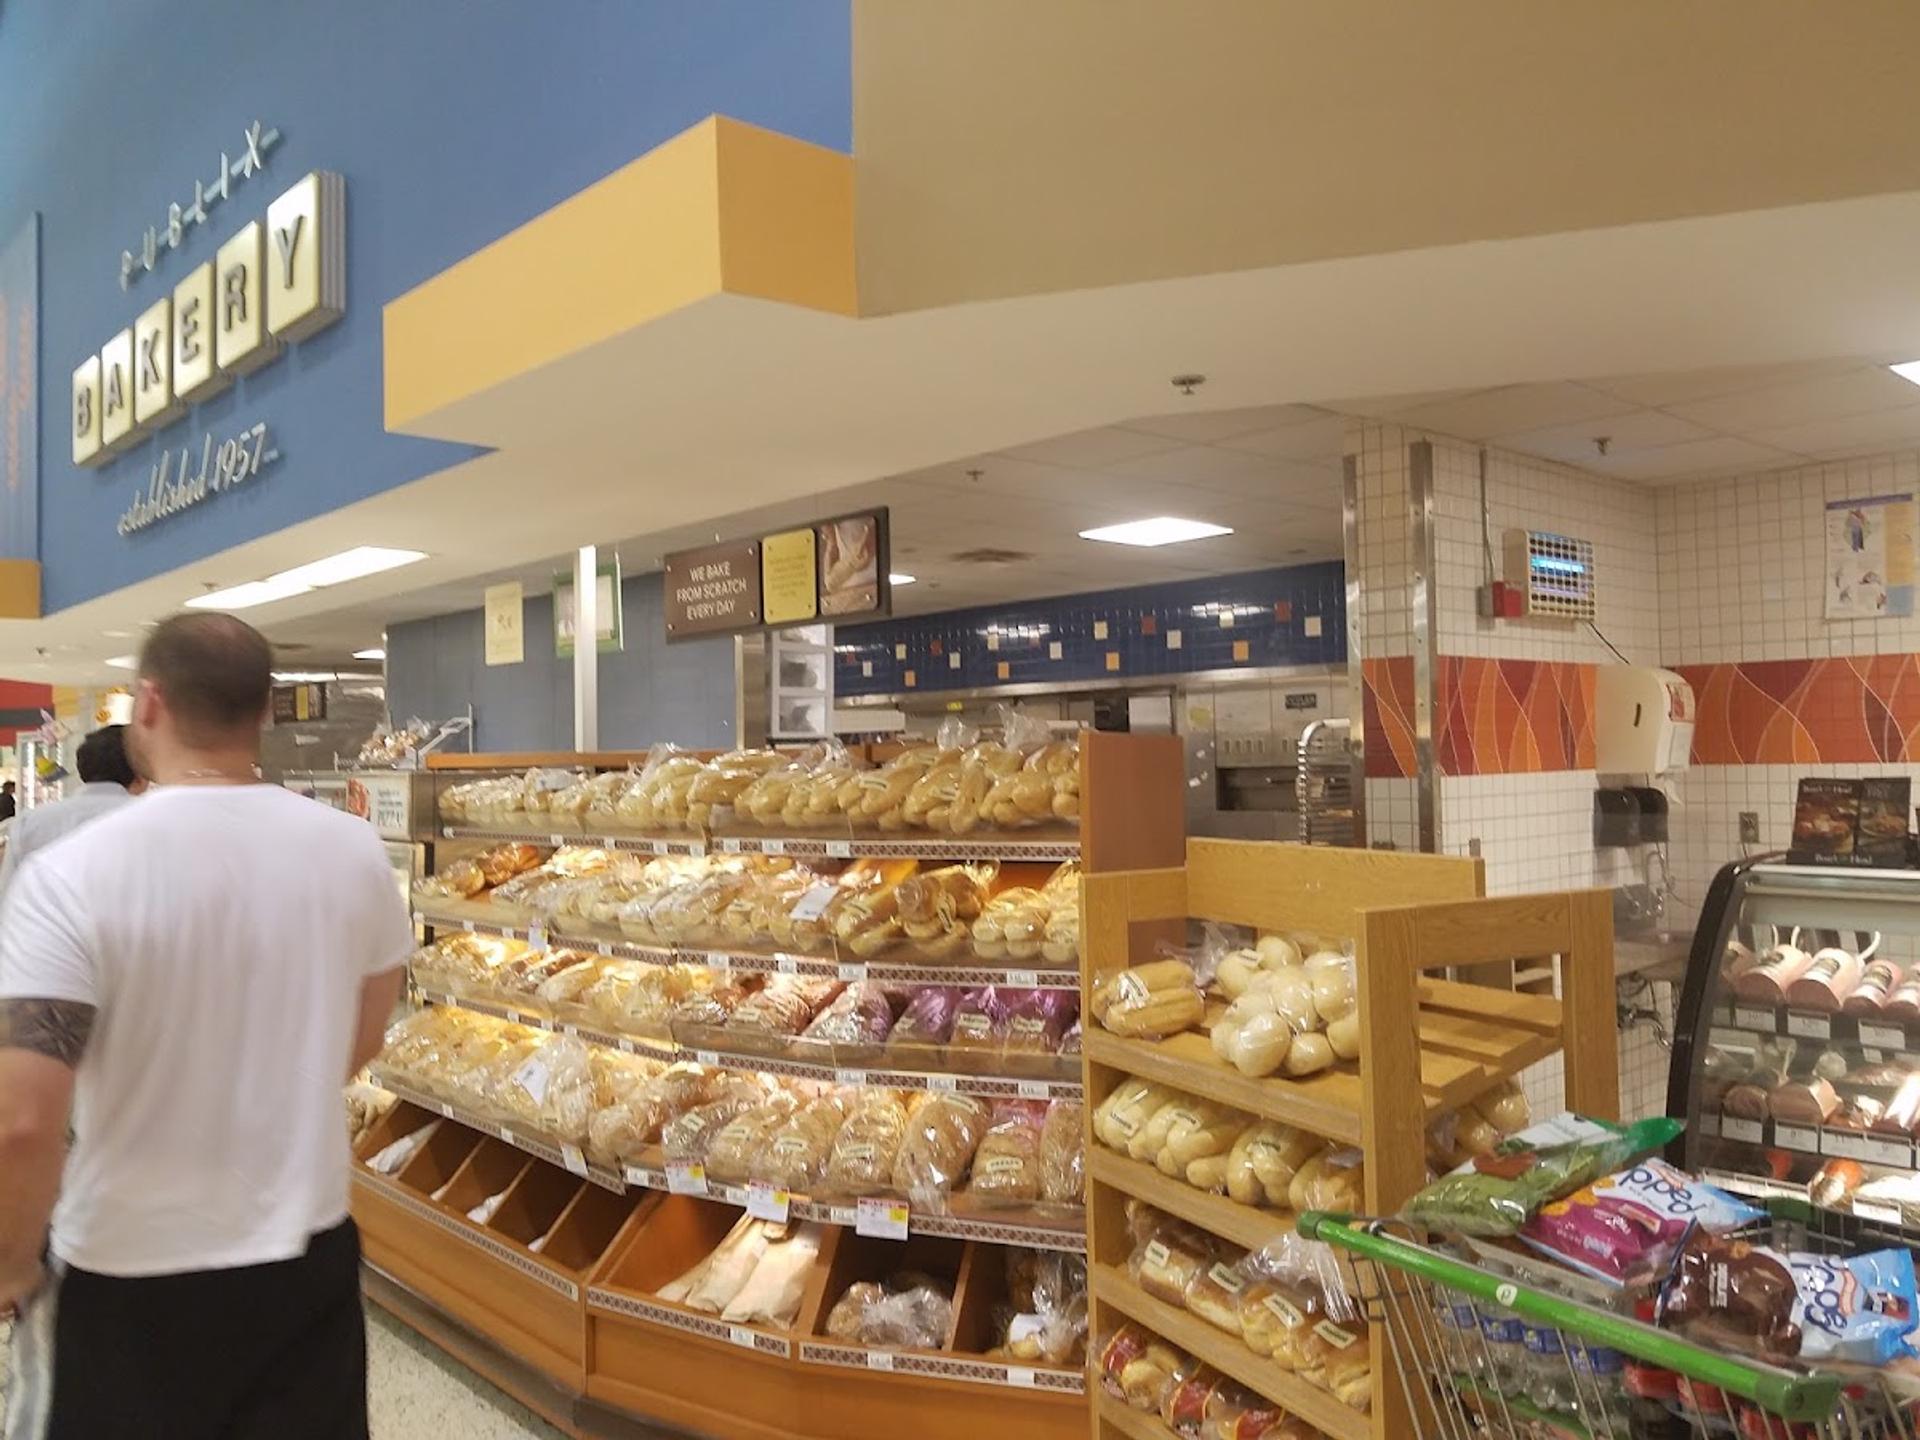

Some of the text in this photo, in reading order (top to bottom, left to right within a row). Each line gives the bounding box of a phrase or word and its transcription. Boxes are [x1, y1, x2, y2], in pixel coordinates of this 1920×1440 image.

[120, 120, 266, 290] PUBLIX
[77, 213, 307, 439] BAKERY
[212, 422, 267, 493] 1957
[676, 577, 747, 604] FROM SCRATCH
[689, 560, 731, 582] WE BAKE
[686, 599, 735, 621] EVERY DAY
